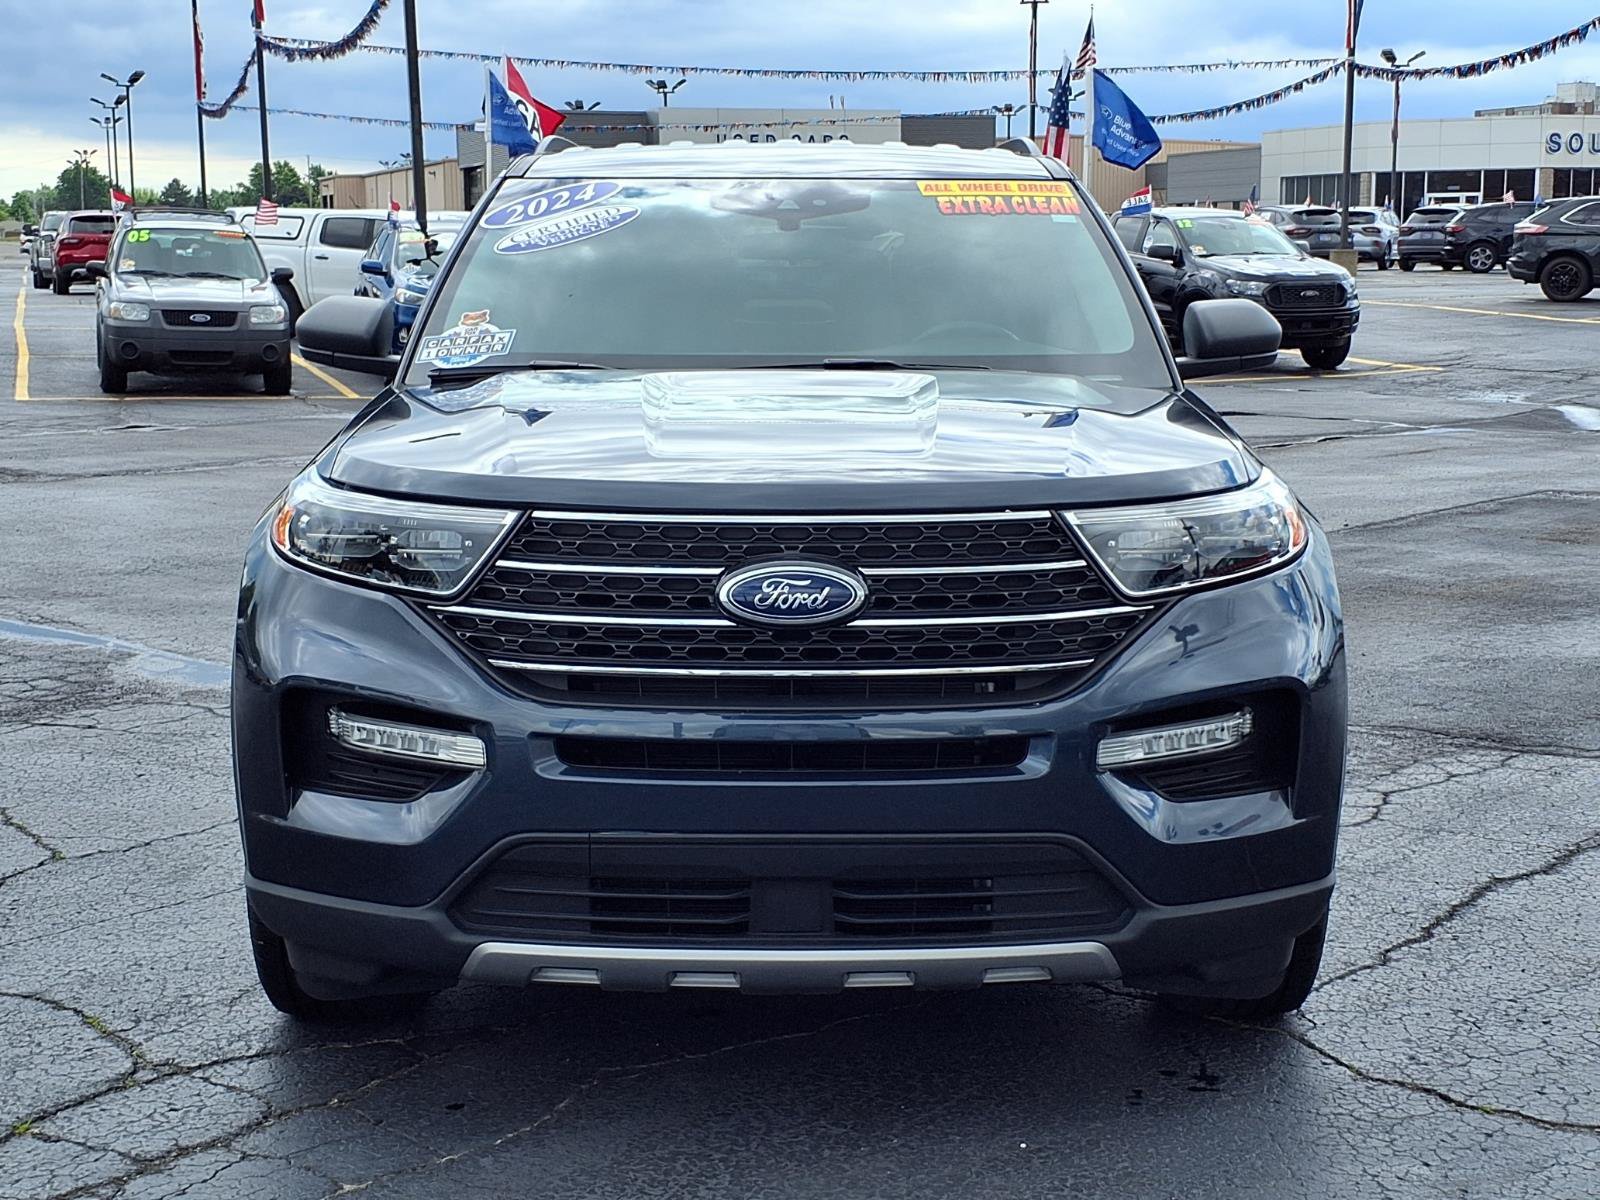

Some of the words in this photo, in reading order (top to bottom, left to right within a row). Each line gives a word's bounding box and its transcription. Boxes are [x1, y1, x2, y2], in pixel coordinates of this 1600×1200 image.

[1113, 115, 1131, 129] Blue
[923, 183, 953, 193] ALL
[957, 183, 1013, 193] WHEEL
[1018, 183, 1064, 193] DRIVE
[505, 183, 595, 225] 2024
[937, 196, 1010, 216] EXTRA
[1011, 196, 1081, 215] CLEAN
[510, 207, 621, 244] CERTIFIED
[537, 220, 611, 247] VEHICLE
[127, 230, 150, 243] 05
[426, 332, 510, 348] CARFAX
[437, 342, 504, 357] OWNER
[754, 577, 831, 609] Ford
